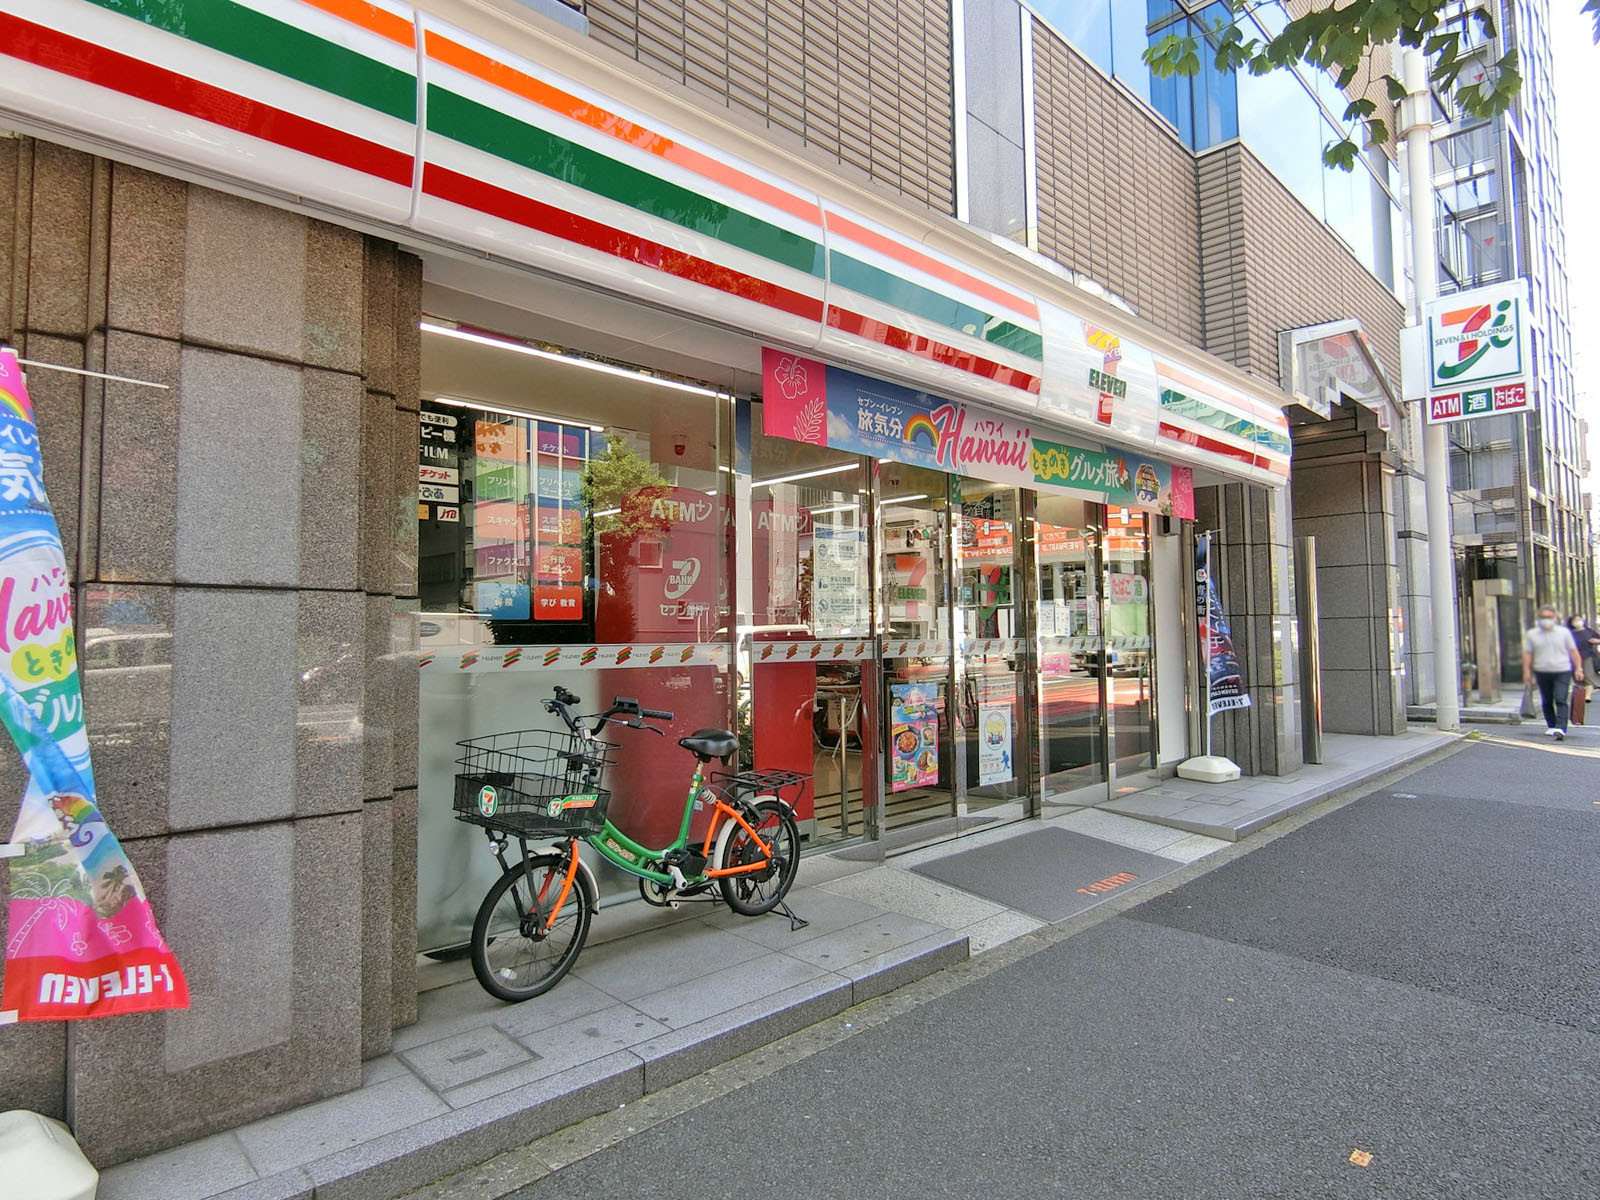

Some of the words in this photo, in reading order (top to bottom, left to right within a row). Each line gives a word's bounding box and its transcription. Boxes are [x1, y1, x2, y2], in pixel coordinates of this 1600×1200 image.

[1471, 324, 1514, 338] HOLDINGS
[1433, 396, 1460, 417] ATM
[1468, 392, 1487, 411] 酒
[1495, 388, 1525, 407] たばこ
[857, 408, 903, 439] 旅気分
[974, 420, 1004, 438] ハワイ
[930, 404, 1028, 472] Hawaii
[1031, 450, 1066, 476] ときめき
[1070, 453, 1119, 488] グルメ旅
[670, 574, 694, 585] BANK
